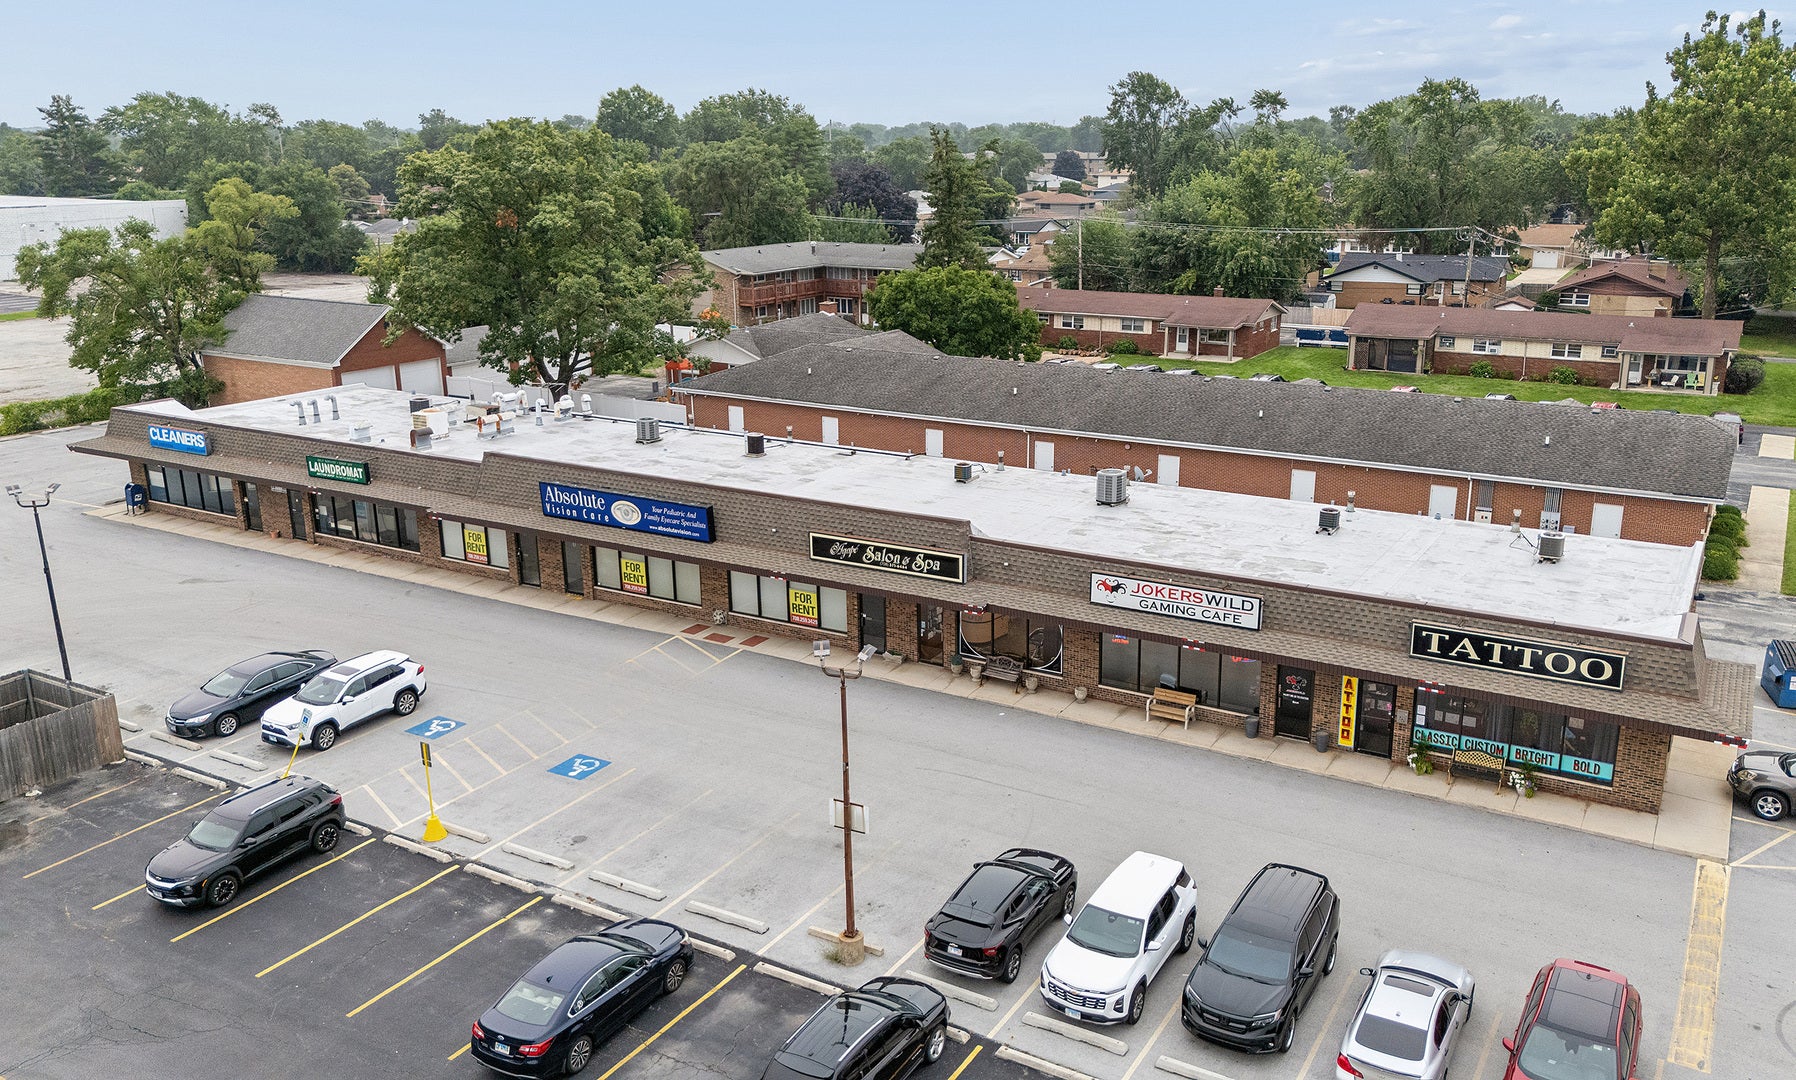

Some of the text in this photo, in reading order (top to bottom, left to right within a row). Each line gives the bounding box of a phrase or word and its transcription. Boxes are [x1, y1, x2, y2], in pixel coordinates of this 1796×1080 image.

[149, 427, 205, 448] CLEANERS
[308, 461, 363, 479] LAUNDROMAT
[545, 485, 605, 511] Absolute
[545, 503, 610, 523] Vision Care
[643, 512, 706, 529] Family Eyecare Specialists
[651, 505, 697, 519] Your Pediatric And
[468, 532, 482, 543] FOR
[466, 541, 486, 554] RENT
[625, 561, 641, 574] FOR
[862, 546, 901, 564] Salon
[912, 553, 941, 573] Spa
[623, 571, 645, 584] RENT
[794, 591, 812, 605] FOR
[791, 602, 816, 617] RENT
[1139, 599, 1243, 625] GAMING CAFE
[1421, 630, 1613, 681] TATTOO
[1414, 729, 1601, 776] CLASSIC CUSTOM BRIGHT BOLD
